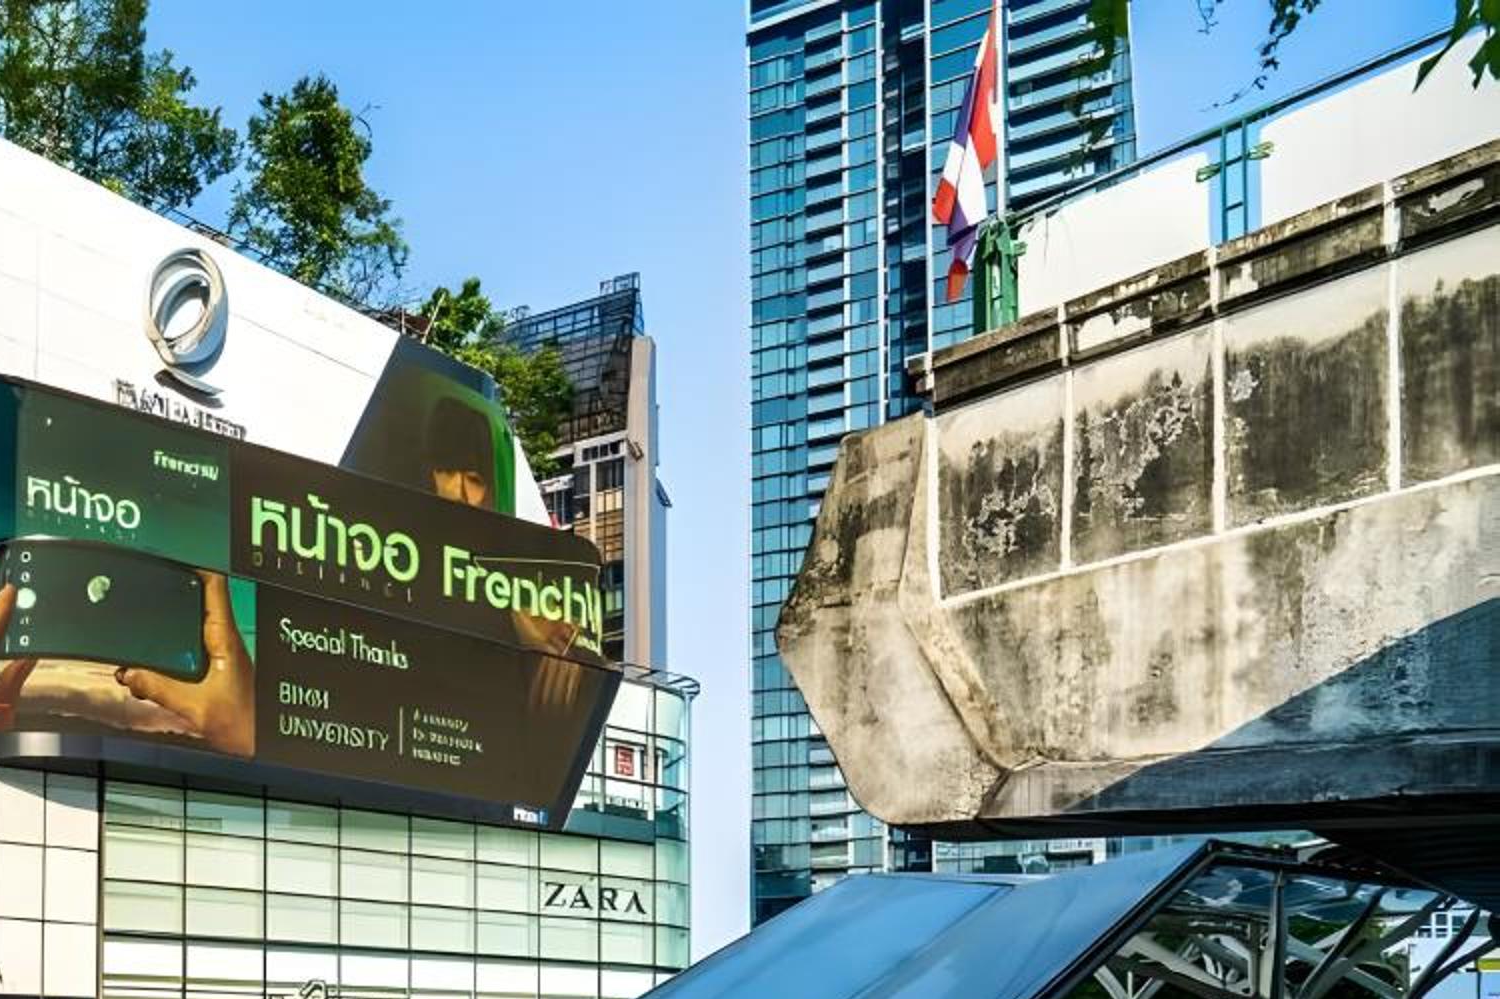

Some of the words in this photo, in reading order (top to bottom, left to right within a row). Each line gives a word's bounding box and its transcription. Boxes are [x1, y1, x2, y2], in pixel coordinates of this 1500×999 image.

[27, 475, 141, 529] หน้าจอ
[251, 493, 419, 582] หน้าจอ
[545, 881, 647, 915] ZARA
